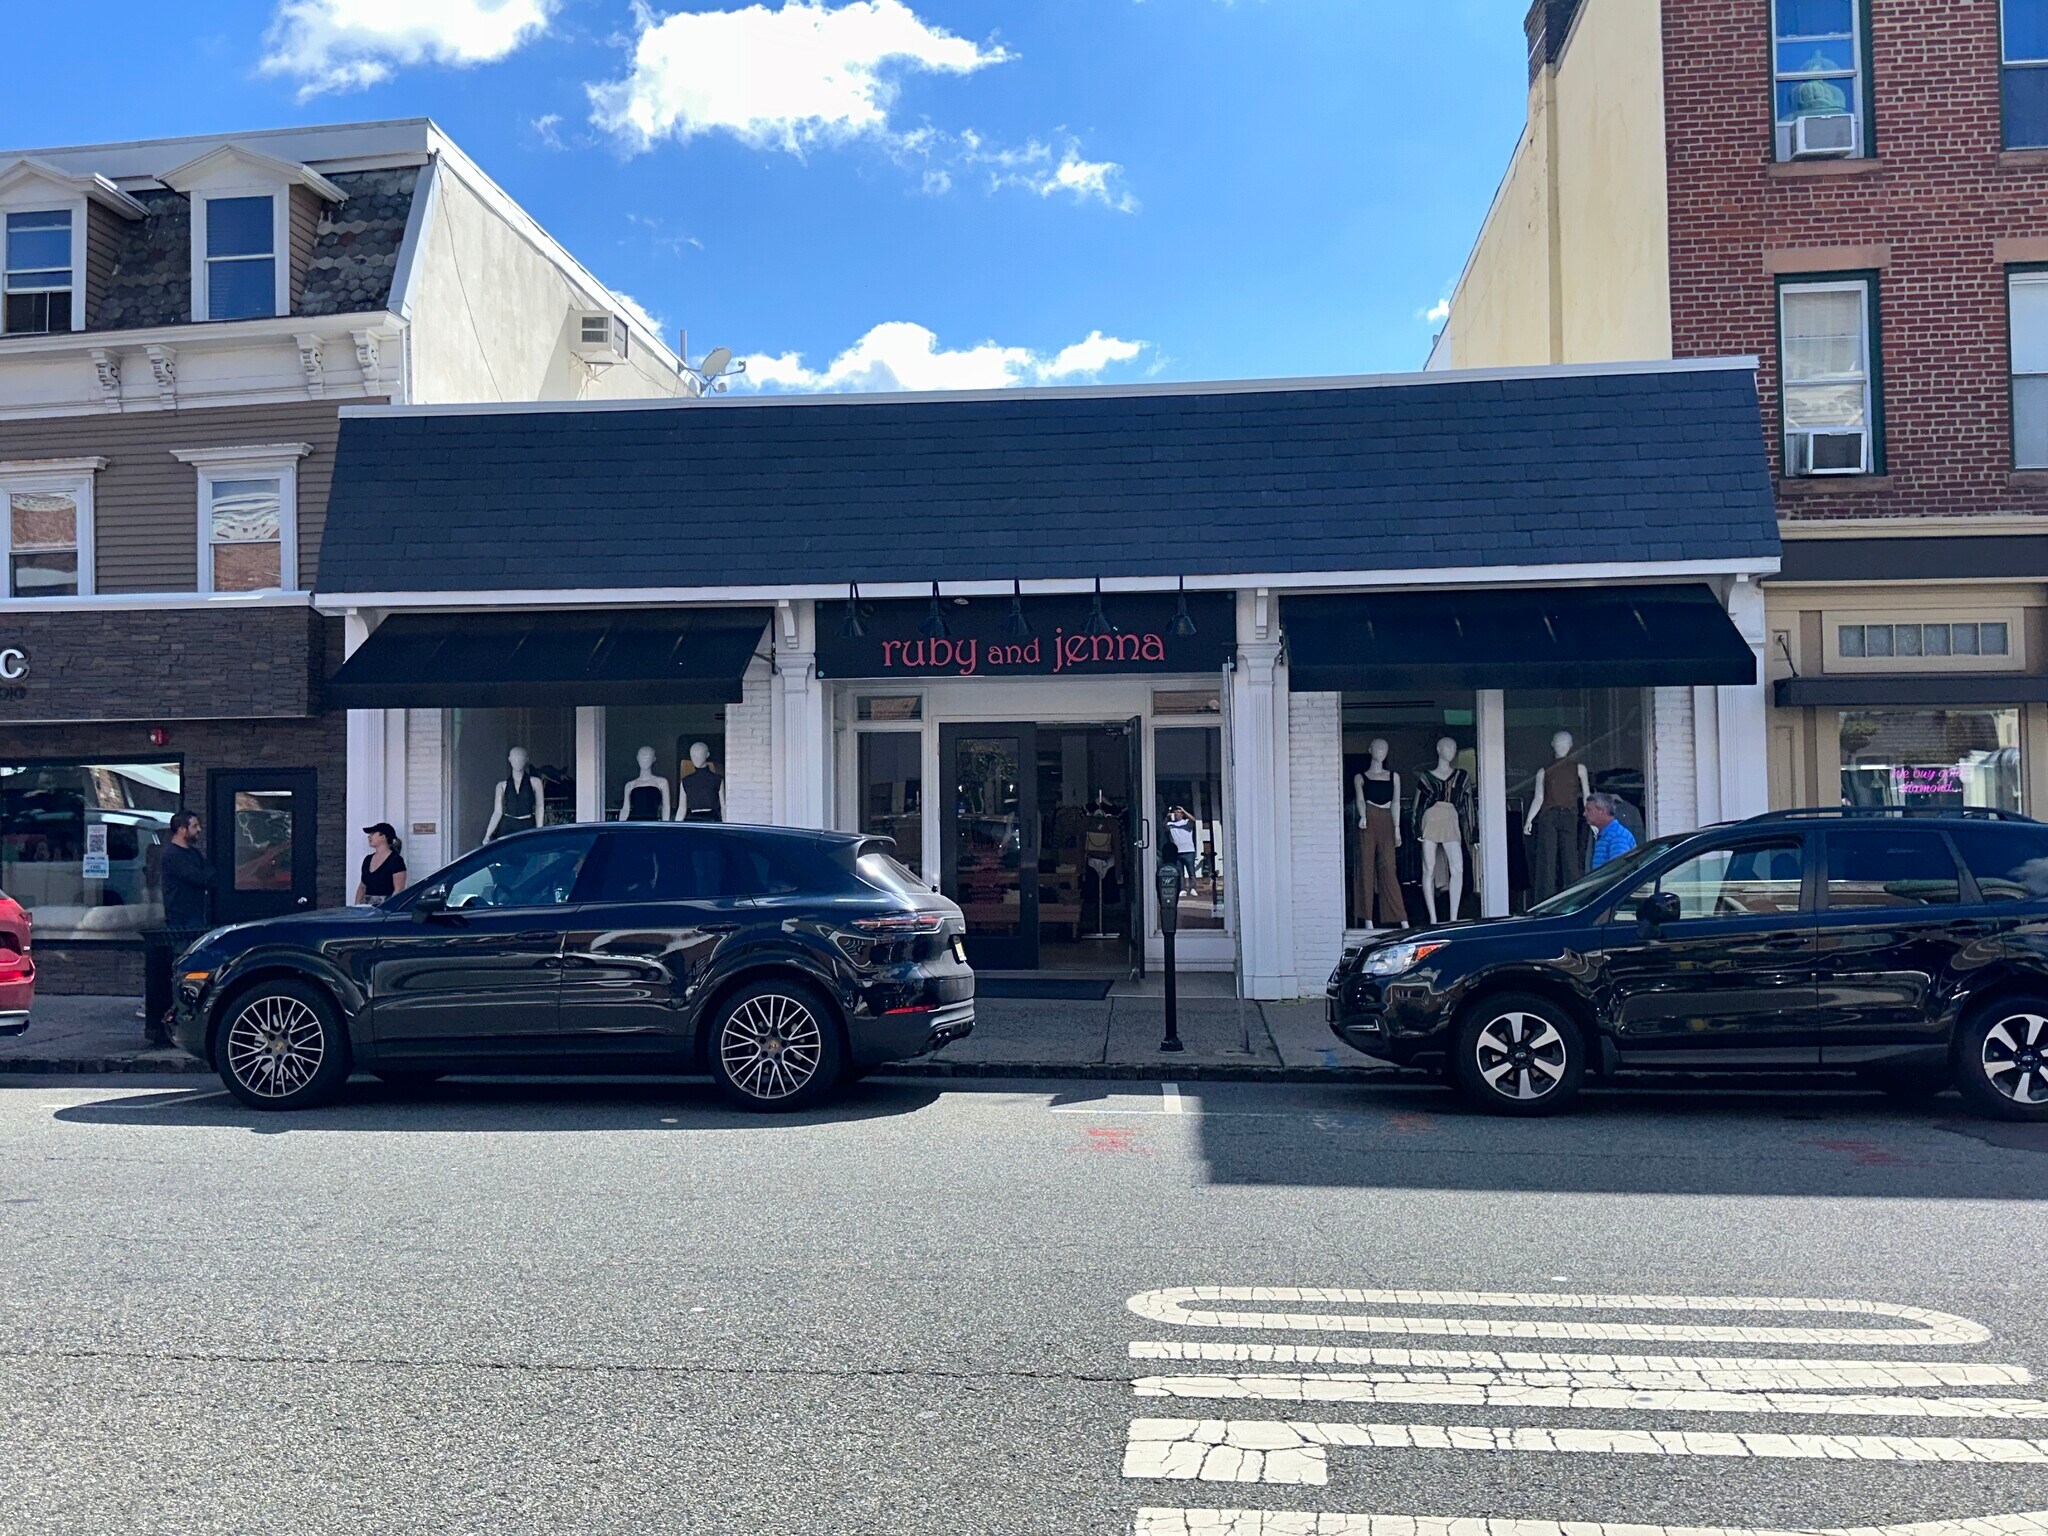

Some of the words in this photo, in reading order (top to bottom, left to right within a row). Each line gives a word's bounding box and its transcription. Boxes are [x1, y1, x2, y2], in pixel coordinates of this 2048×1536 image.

[881, 637, 977, 675] ruby
[988, 638, 1041, 664] and
[1053, 627, 1165, 673] jenna
